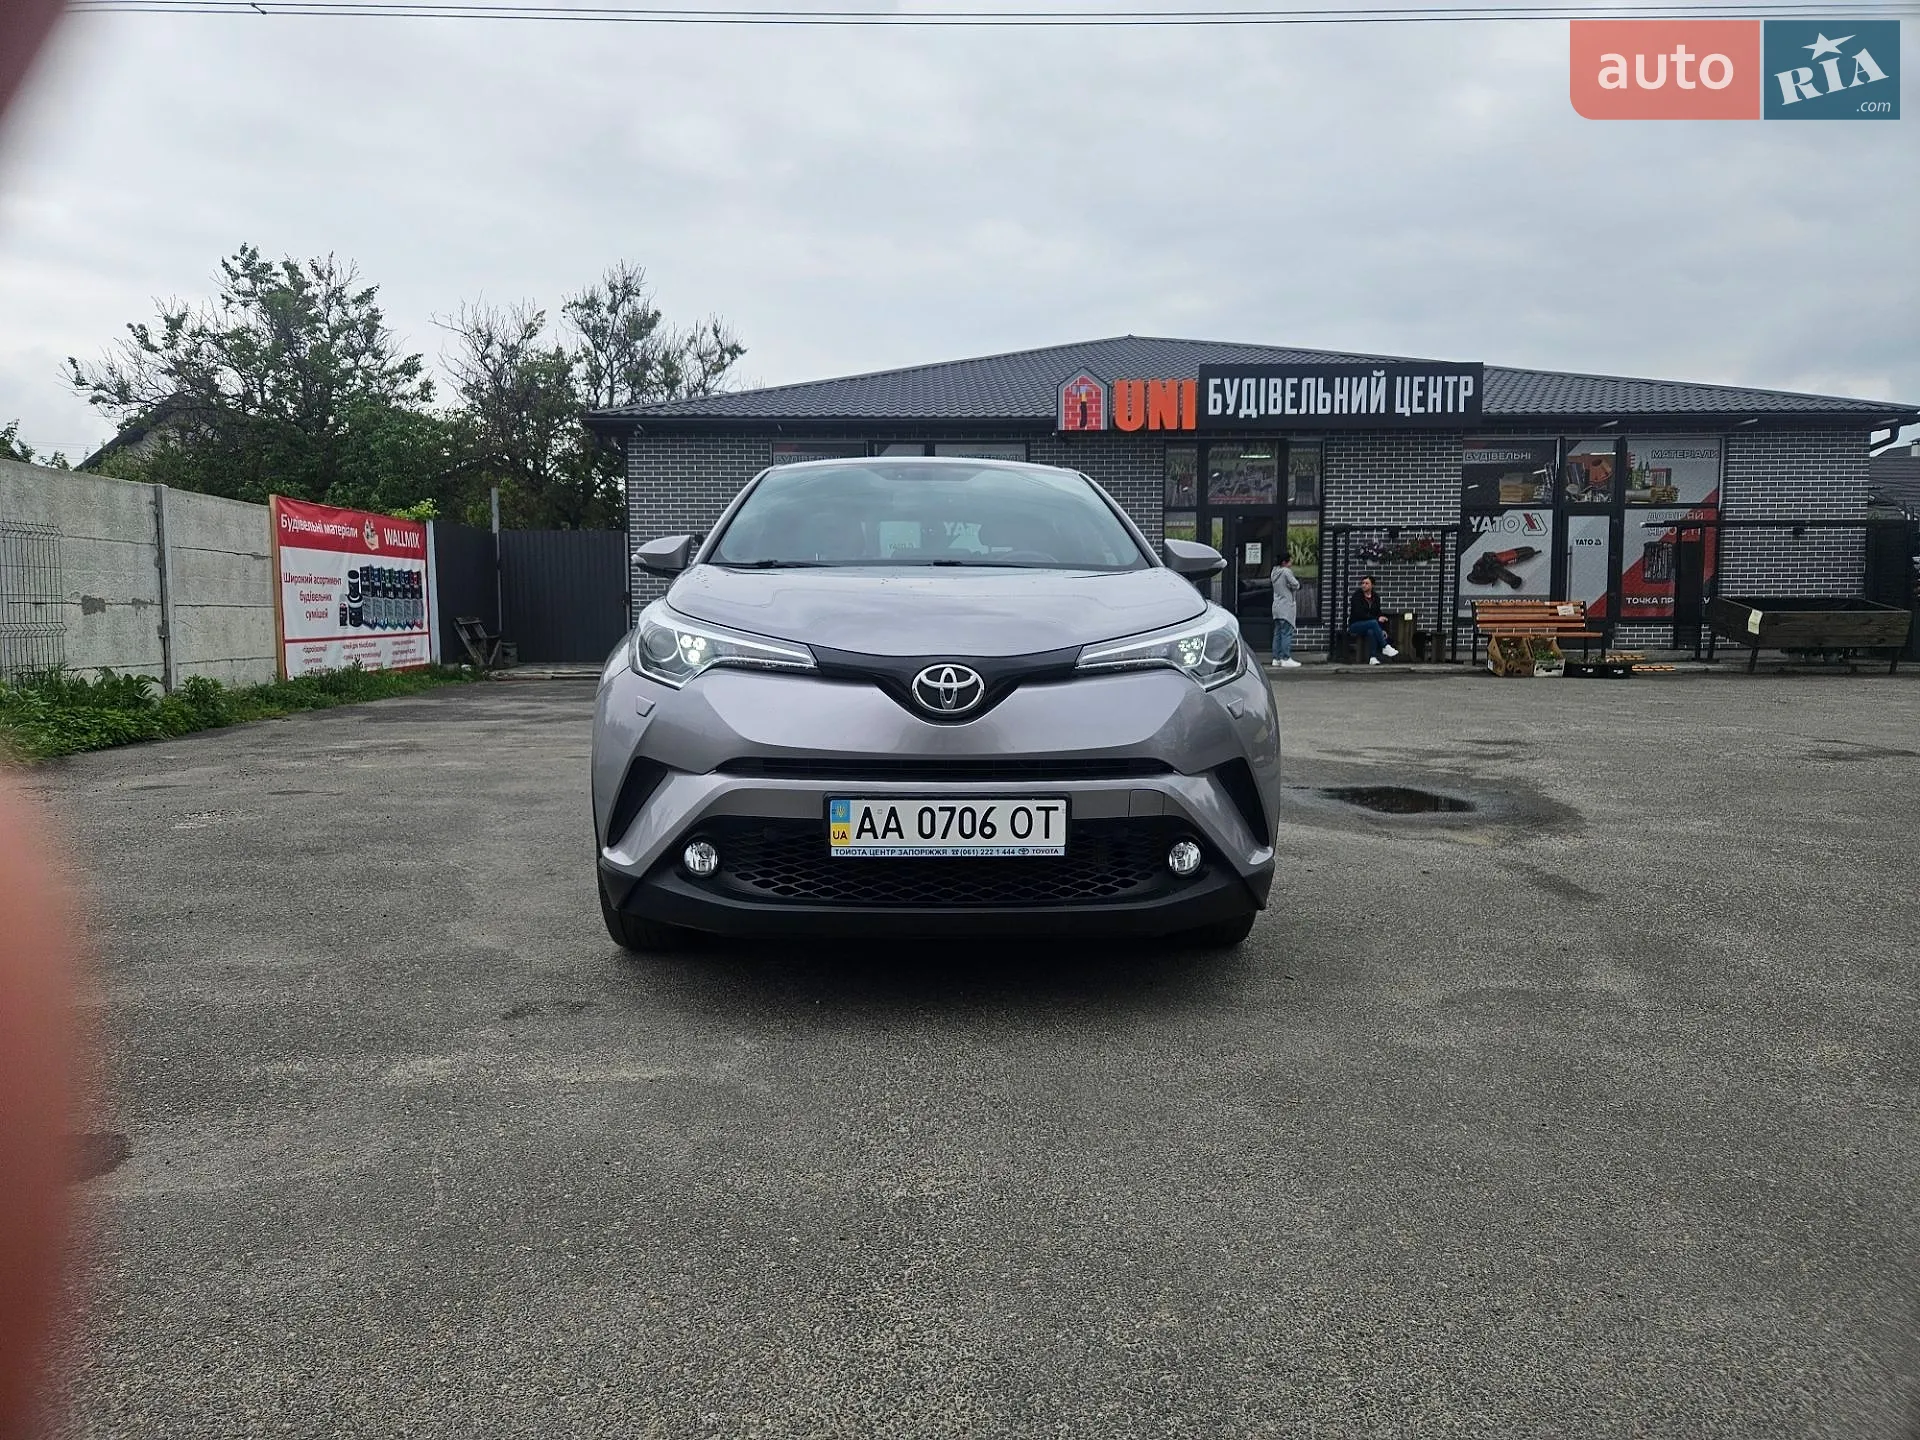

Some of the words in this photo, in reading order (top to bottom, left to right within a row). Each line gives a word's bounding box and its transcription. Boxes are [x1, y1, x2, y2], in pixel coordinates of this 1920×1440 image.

[1208, 370, 1387, 418] БУДІВЕЛЬНИЙ
[1395, 375, 1474, 417] ЦЕНТР
[1114, 378, 1196, 432] UNI
[1465, 451, 1531, 462] БУДІВЕЛЬНІ
[1651, 448, 1720, 459] МАТЕРІАЛИ
[280, 513, 324, 533] Будівельні
[323, 523, 358, 539] матеріали
[1469, 515, 1520, 533] YATO
[383, 527, 420, 549] WALLMIX
[1575, 538, 1594, 546] YATO
[283, 572, 313, 586] Широкий
[1626, 597, 1659, 605] ТОЧКА
[856, 806, 904, 839] AA
[917, 806, 997, 839] 0706
[1010, 806, 1059, 839] OT
[832, 830, 848, 840] UA
[869, 848, 896, 857] ЦЕНТР
[898, 848, 948, 856] ЗАПОРІЖЖЯ
[980, 848, 994, 856] 222
[1002, 848, 1016, 856] 444
